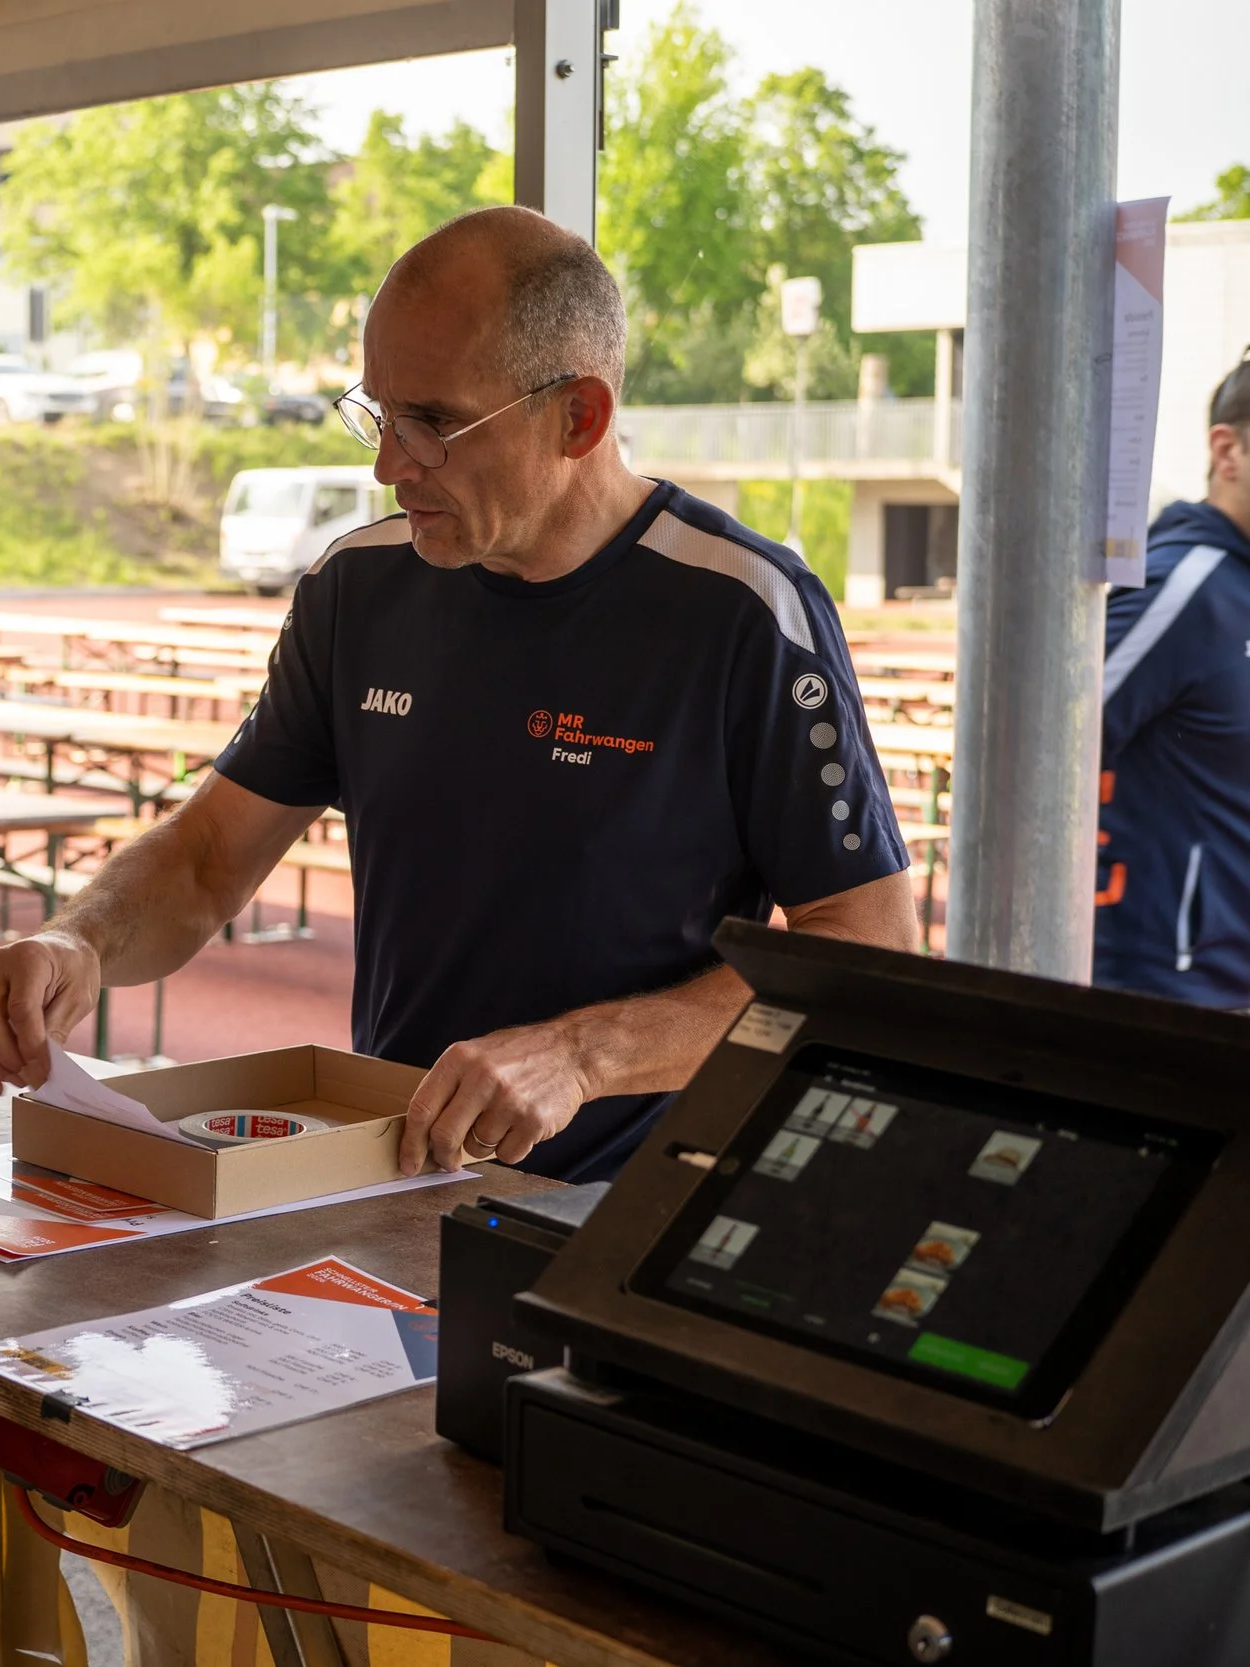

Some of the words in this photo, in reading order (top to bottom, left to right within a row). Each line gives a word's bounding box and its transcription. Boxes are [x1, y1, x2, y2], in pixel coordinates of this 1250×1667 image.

[360, 688, 412, 717] JAKO
[557, 713, 584, 730] MR
[554, 728, 654, 753] Fahrwangen
[552, 748, 592, 765] Fredi
[240, 1293, 292, 1315] Preisliste
[492, 1341, 534, 1370] EPSON
